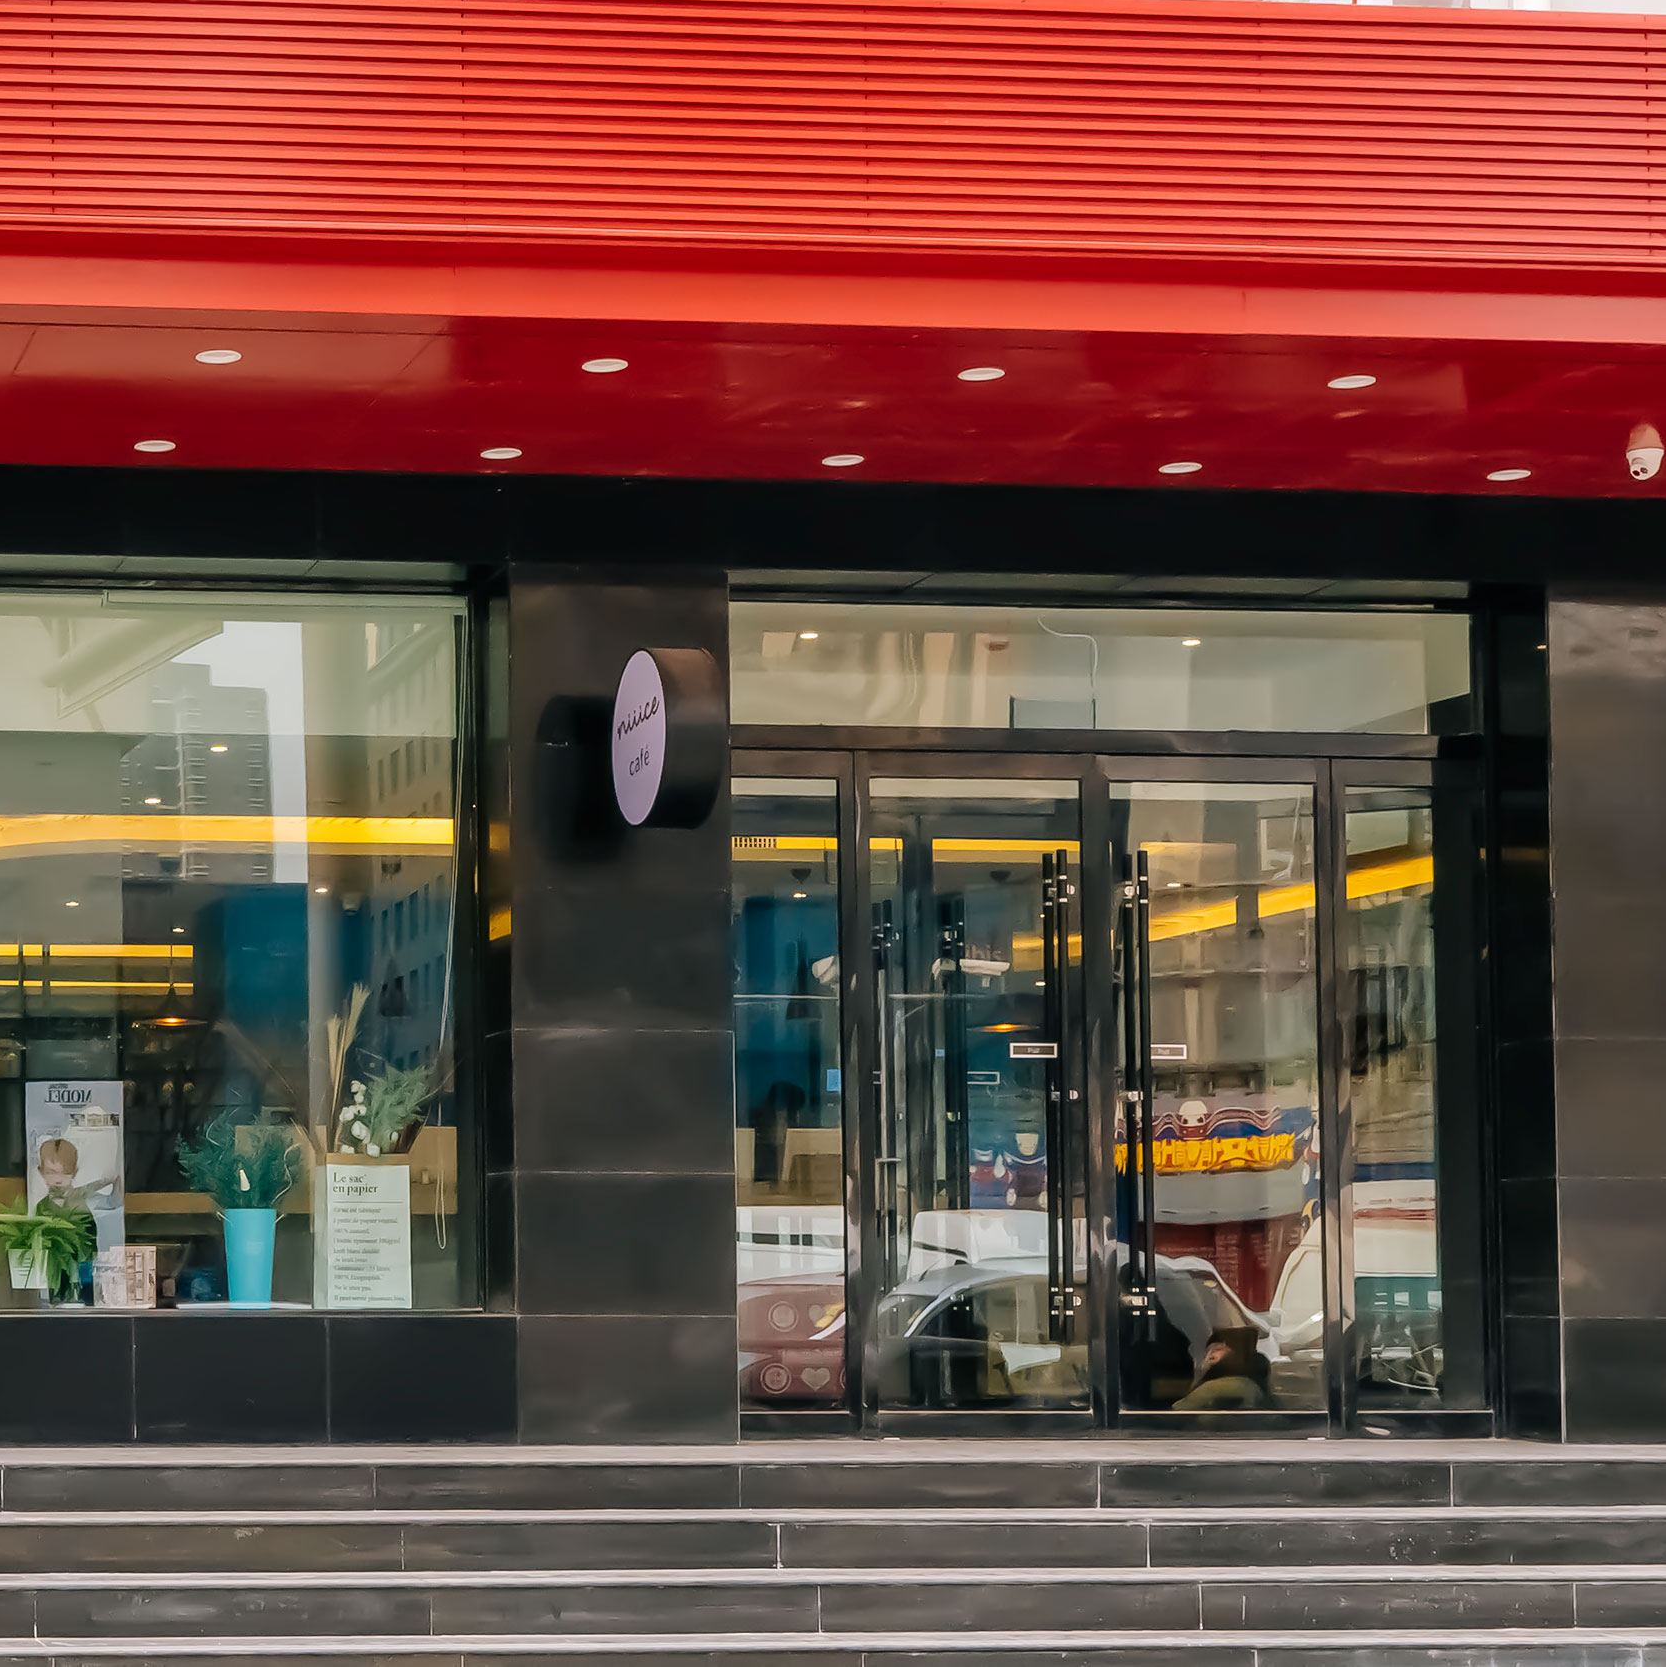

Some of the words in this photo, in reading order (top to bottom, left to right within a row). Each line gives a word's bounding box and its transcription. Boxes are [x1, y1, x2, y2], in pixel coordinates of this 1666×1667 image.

[629, 745, 650, 776] café
[333, 1172, 347, 1183] Le
[349, 1175, 363, 1183] sac
[333, 1185, 345, 1193] en
[347, 1183, 379, 1196] papier
